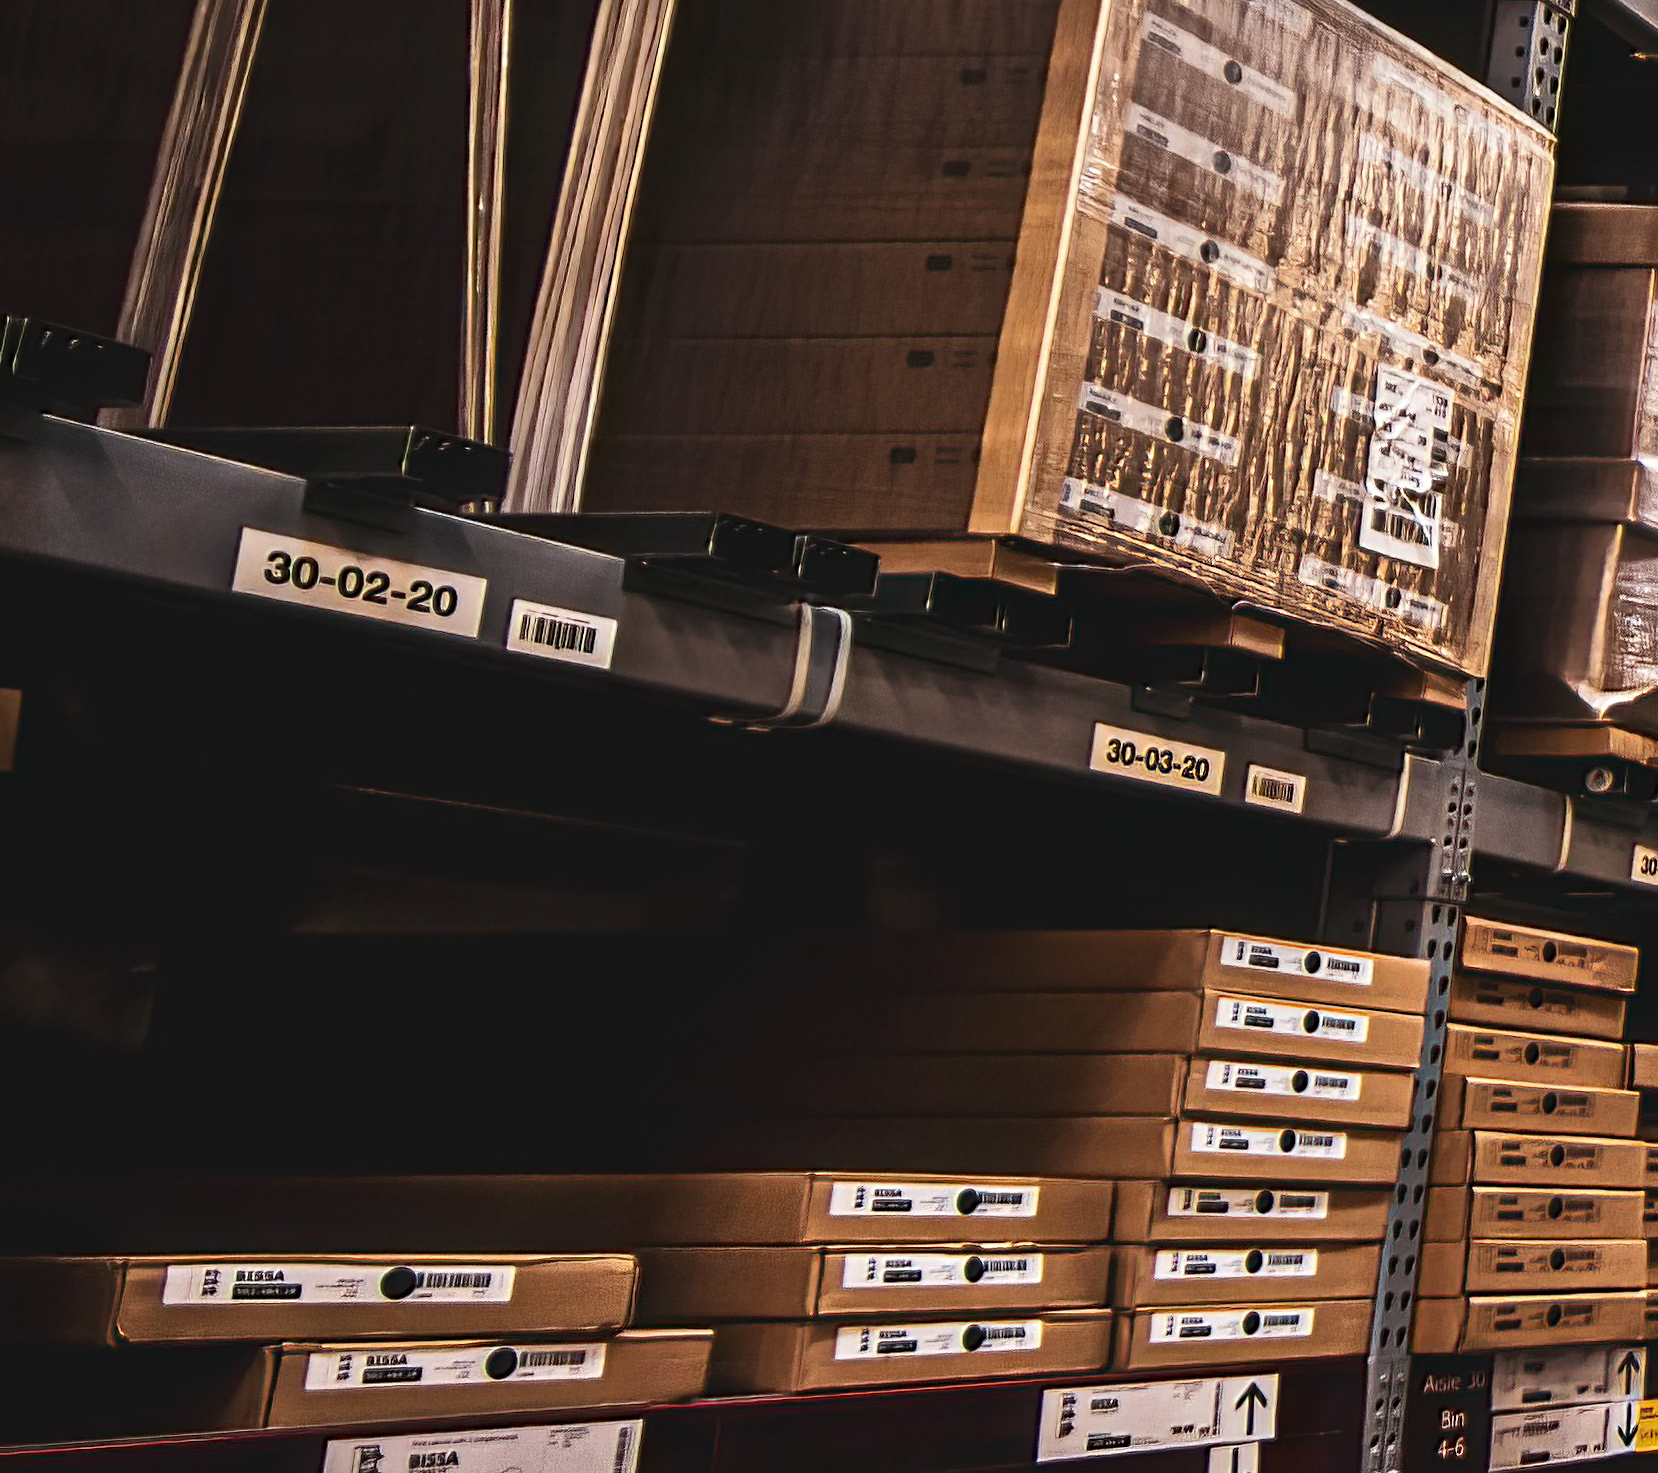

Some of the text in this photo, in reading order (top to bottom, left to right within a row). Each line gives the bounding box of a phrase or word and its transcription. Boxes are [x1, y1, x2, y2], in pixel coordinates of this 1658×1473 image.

[264, 550, 459, 617] 30-02-20
[1106, 738, 1210, 783] 30-03-20
[1424, 1374, 1461, 1393] Aisle
[1441, 1410, 1465, 1429] Bin
[1437, 1438, 1465, 1458] 4-6
